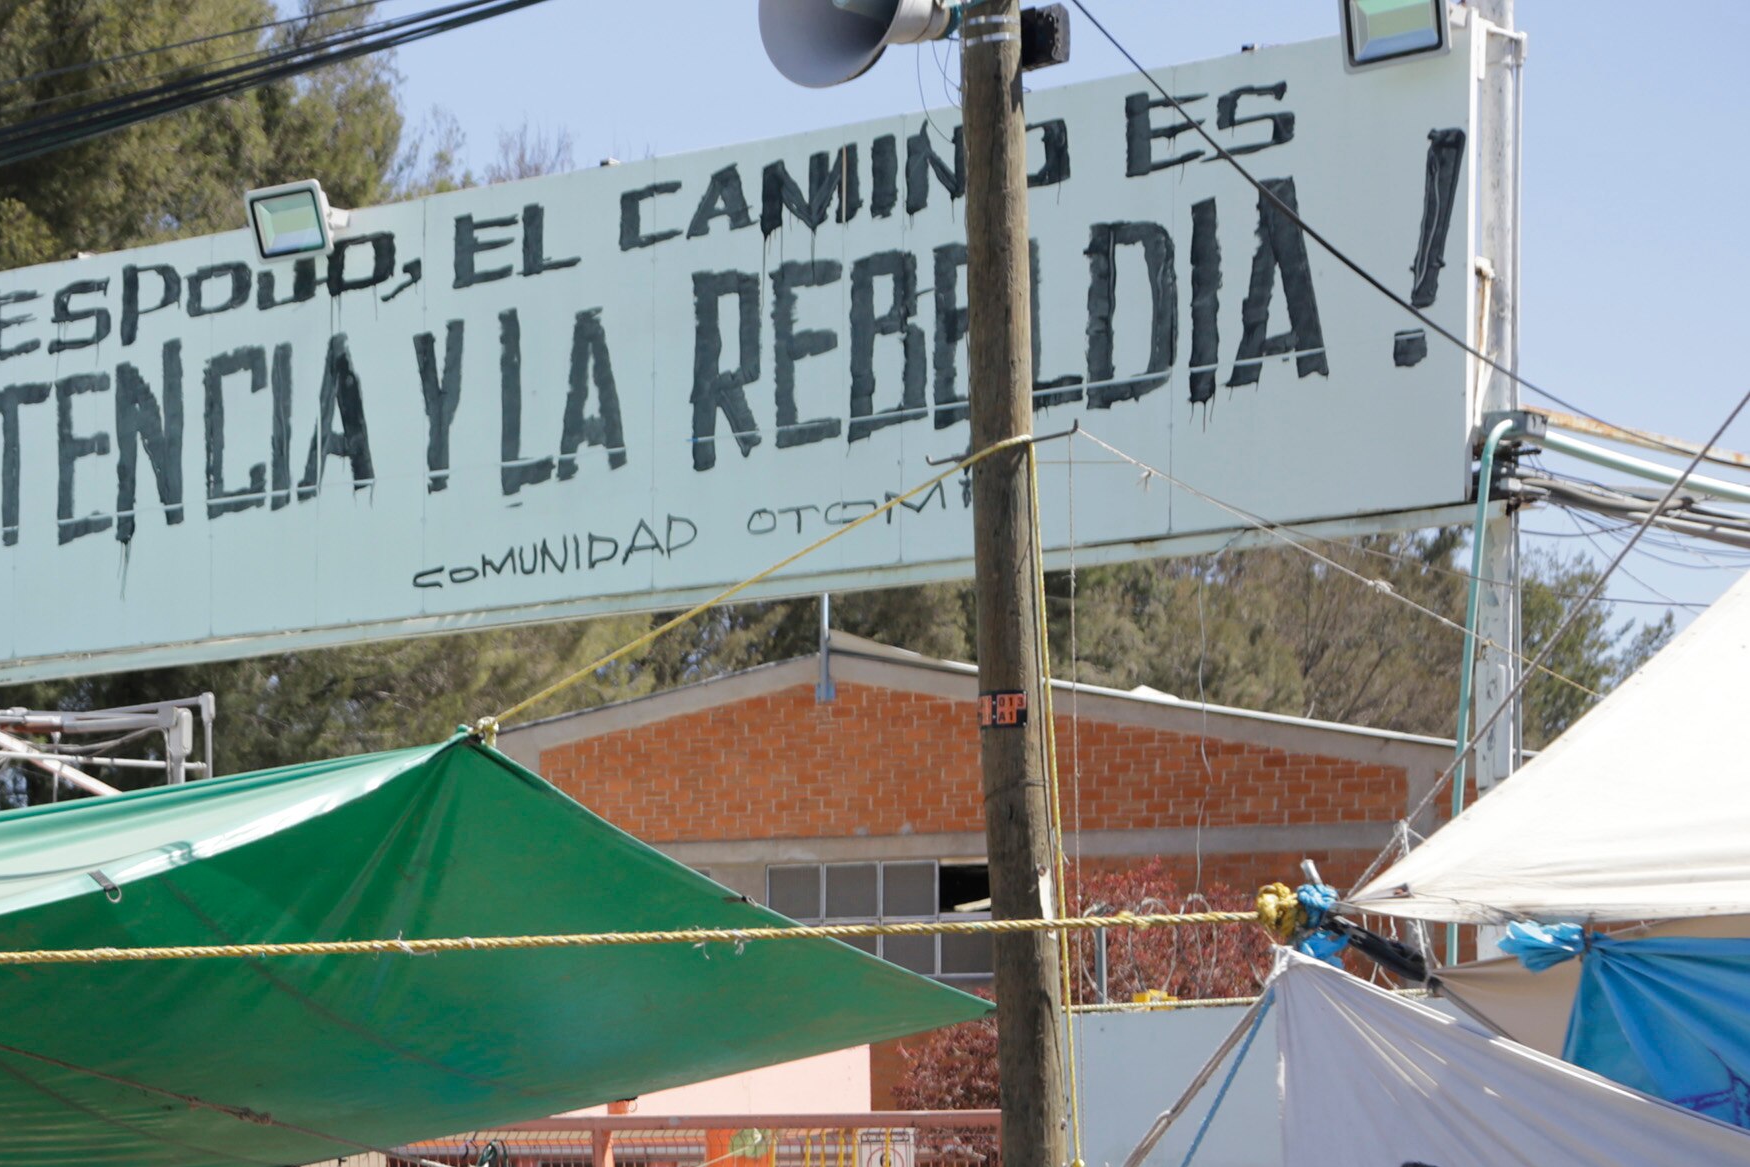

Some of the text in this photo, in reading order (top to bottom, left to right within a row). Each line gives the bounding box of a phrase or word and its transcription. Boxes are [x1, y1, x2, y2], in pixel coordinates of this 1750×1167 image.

[453, 205, 581, 289] EL
[619, 118, 1071, 251] CAMINO
[1125, 81, 1296, 177] ES
[412, 319, 465, 494] Y
[500, 306, 627, 500] LA
[412, 514, 698, 588] COMUNIDAD
